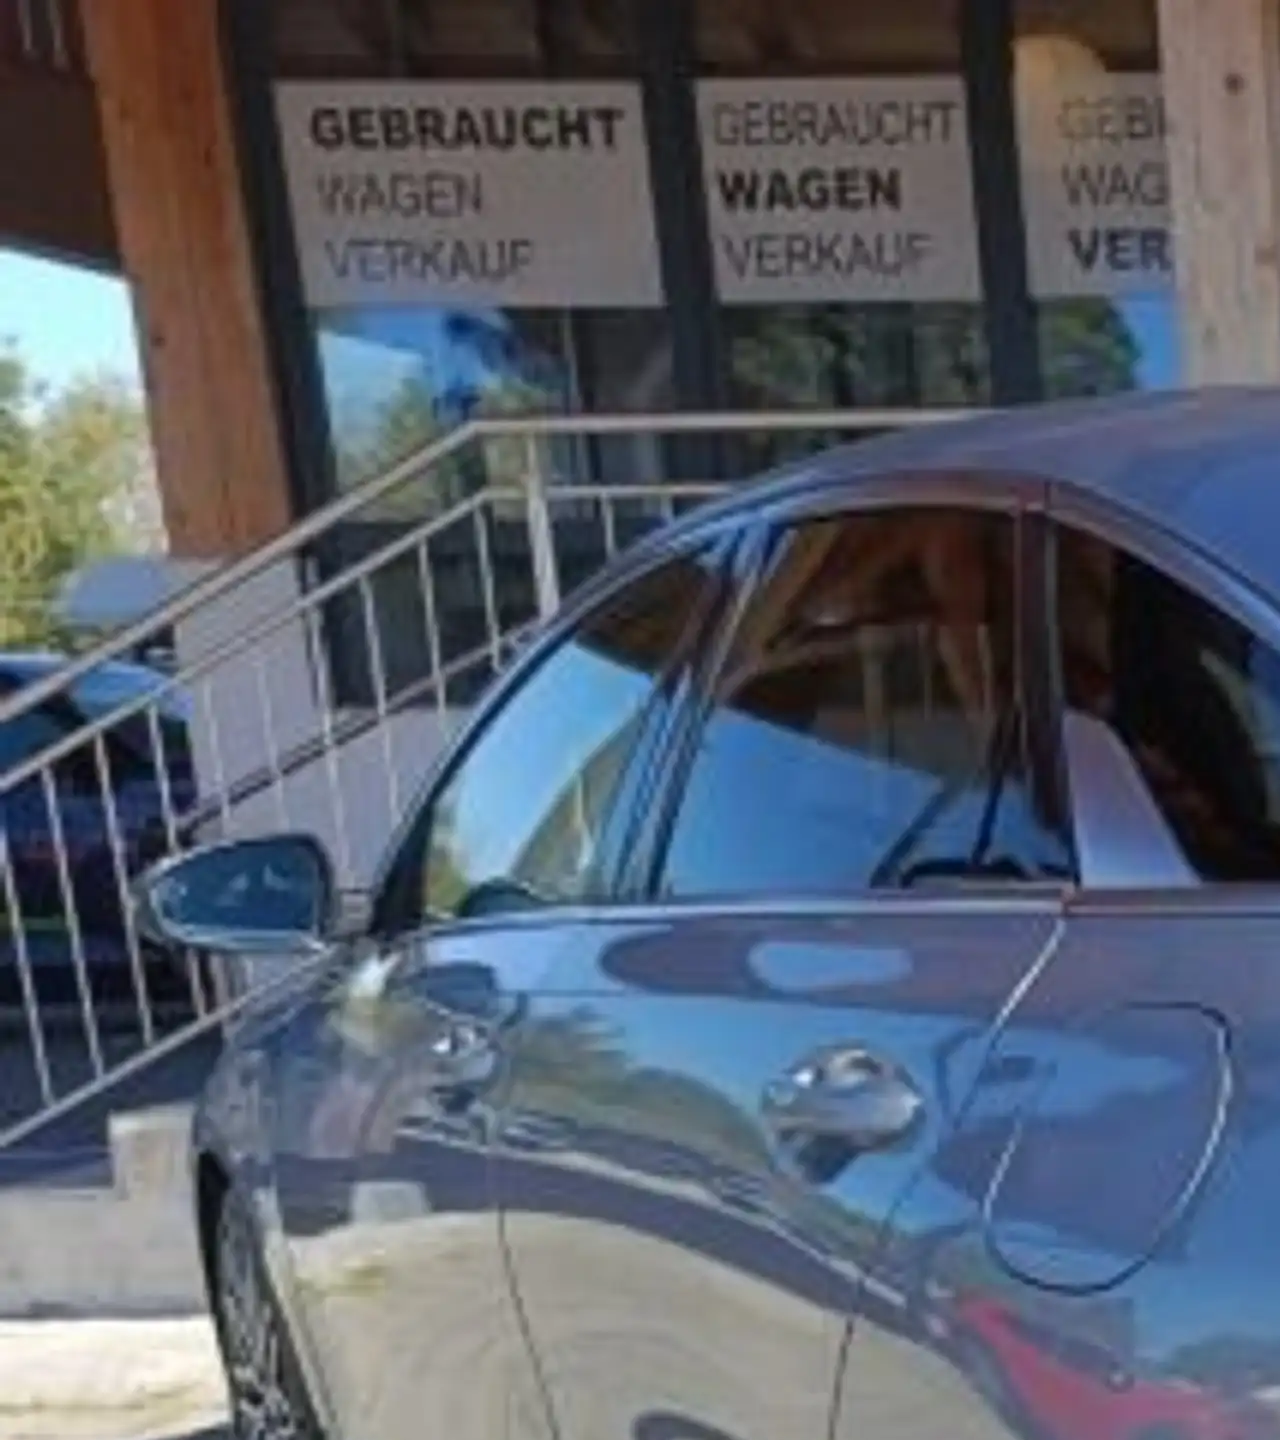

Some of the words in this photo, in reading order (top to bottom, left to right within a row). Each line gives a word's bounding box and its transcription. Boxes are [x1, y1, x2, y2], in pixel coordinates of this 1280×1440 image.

[309, 107, 626, 150] GEBRAUCHT
[713, 101, 961, 148] GEBRAUCHT
[317, 171, 484, 217] WAGEN
[717, 169, 901, 212] WAGEN
[1061, 162, 1172, 206] WAG
[325, 239, 535, 282] VERKAUF
[724, 233, 932, 279] VERKAUF
